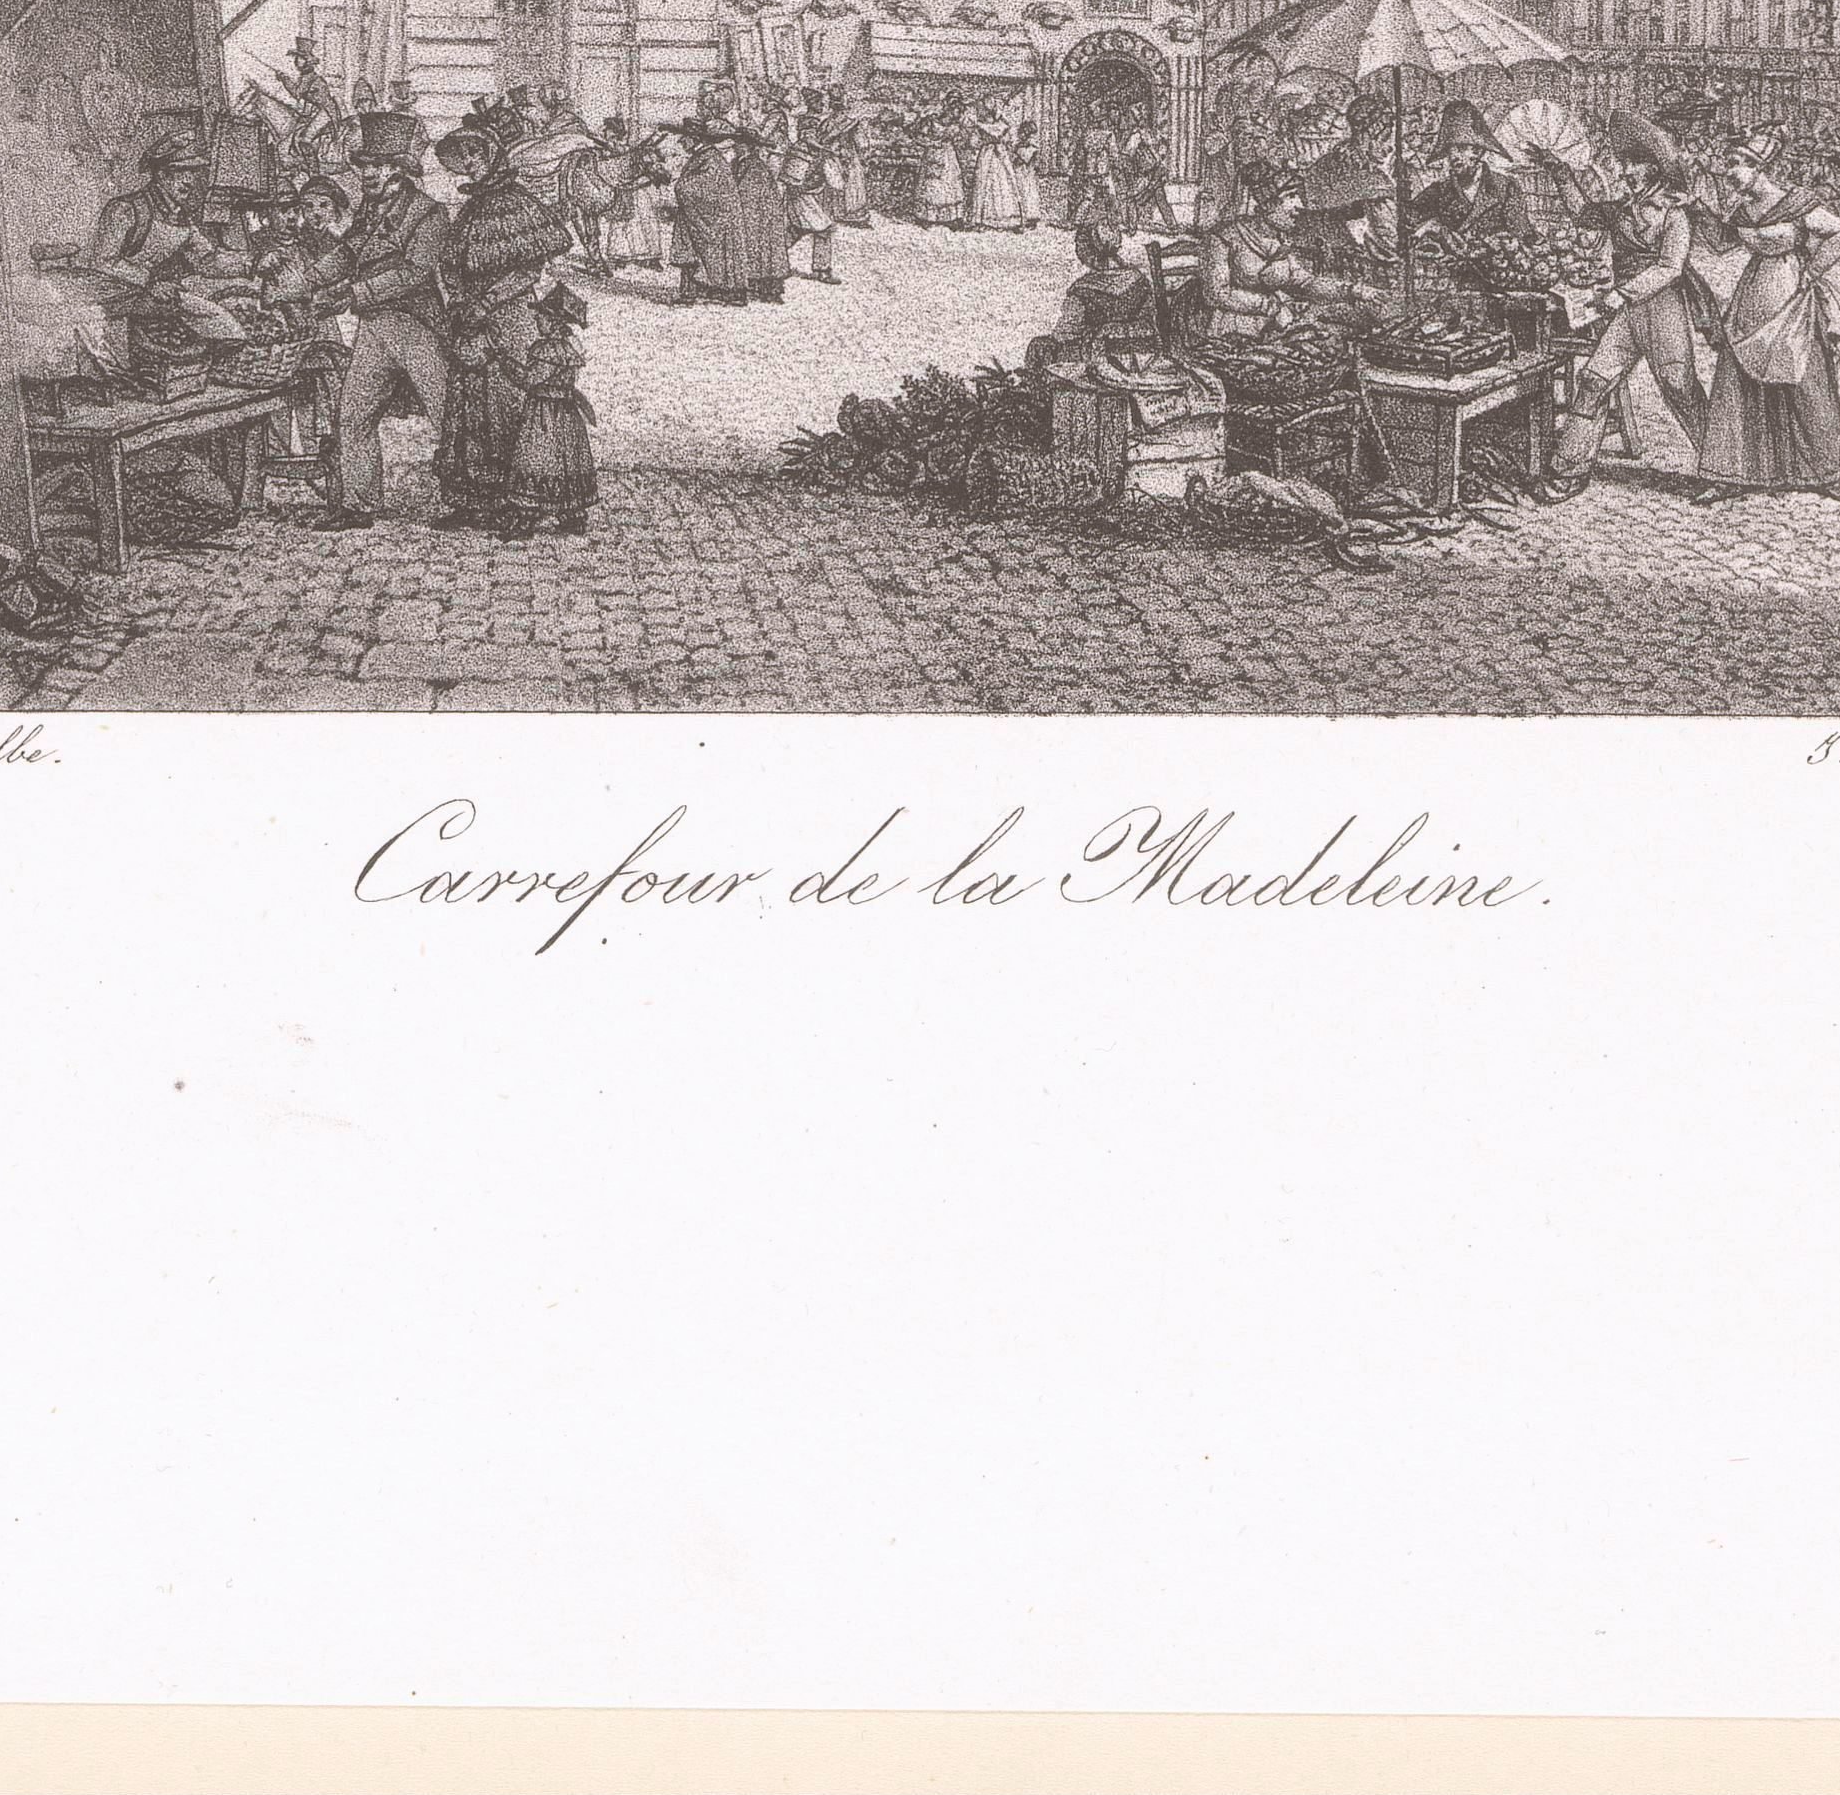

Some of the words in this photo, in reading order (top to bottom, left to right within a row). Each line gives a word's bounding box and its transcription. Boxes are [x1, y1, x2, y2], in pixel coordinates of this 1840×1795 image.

[354, 799, 770, 955] Carrefour
[789, 807, 909, 905] de
[917, 806, 1045, 905] la
[1060, 806, 1550, 907] Madeleine.
